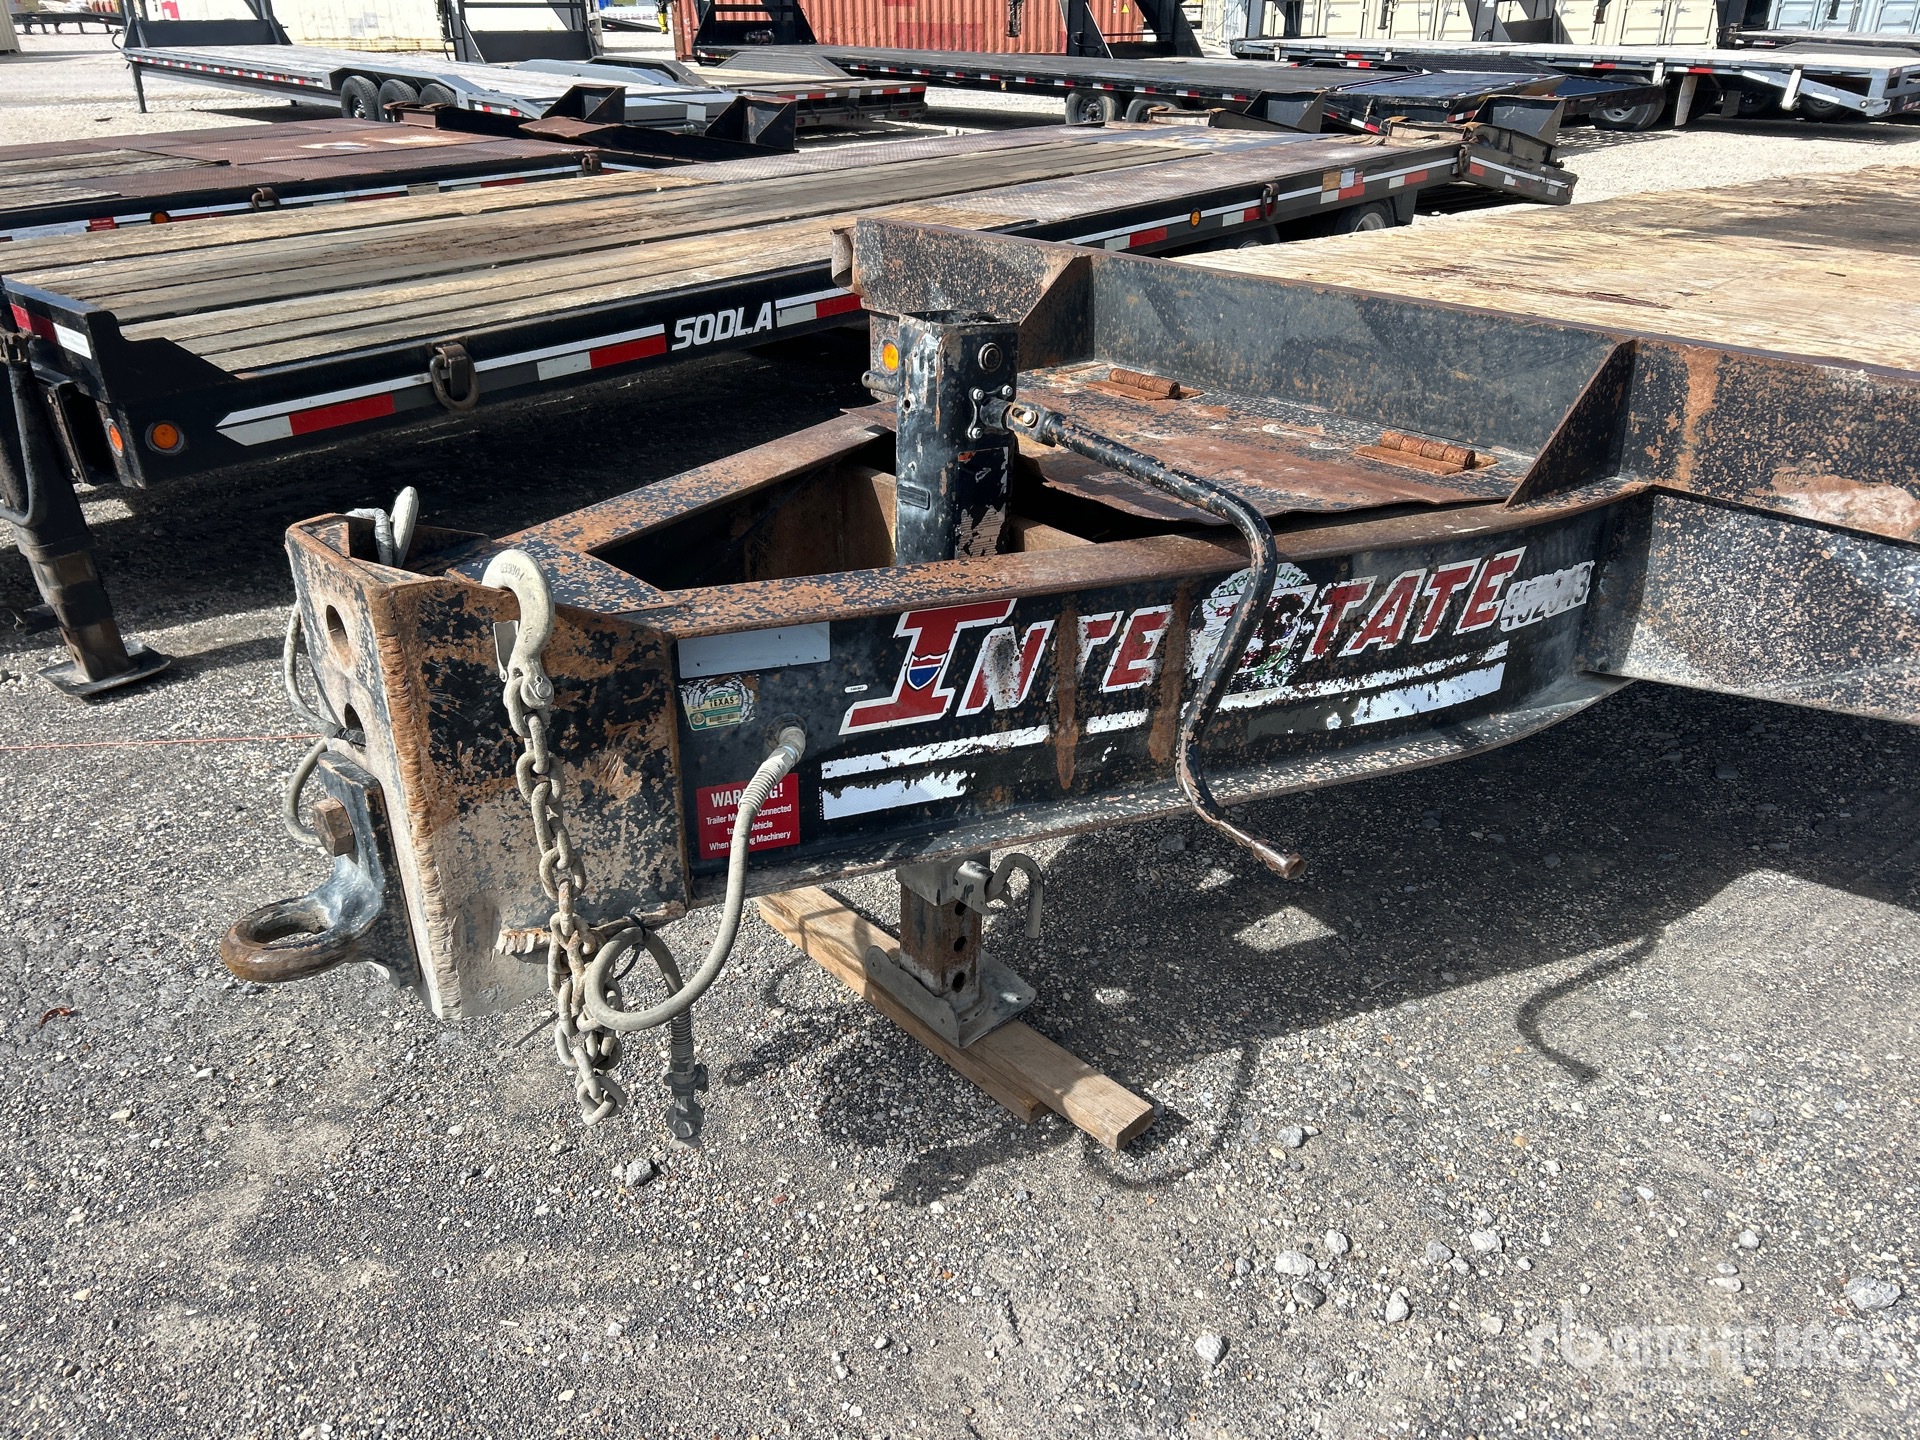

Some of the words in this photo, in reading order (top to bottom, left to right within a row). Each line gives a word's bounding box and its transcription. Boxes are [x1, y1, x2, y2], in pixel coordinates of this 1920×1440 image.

[671, 301, 772, 351] SODLA
[838, 545, 1528, 735] INTETATE
[709, 696, 735, 708] TEXAS
[711, 782, 784, 808] WARG!
[706, 815, 727, 826] Trailer
[757, 804, 792, 817] Connected
[709, 841, 729, 851] When
[756, 831, 792, 844] Machinery
